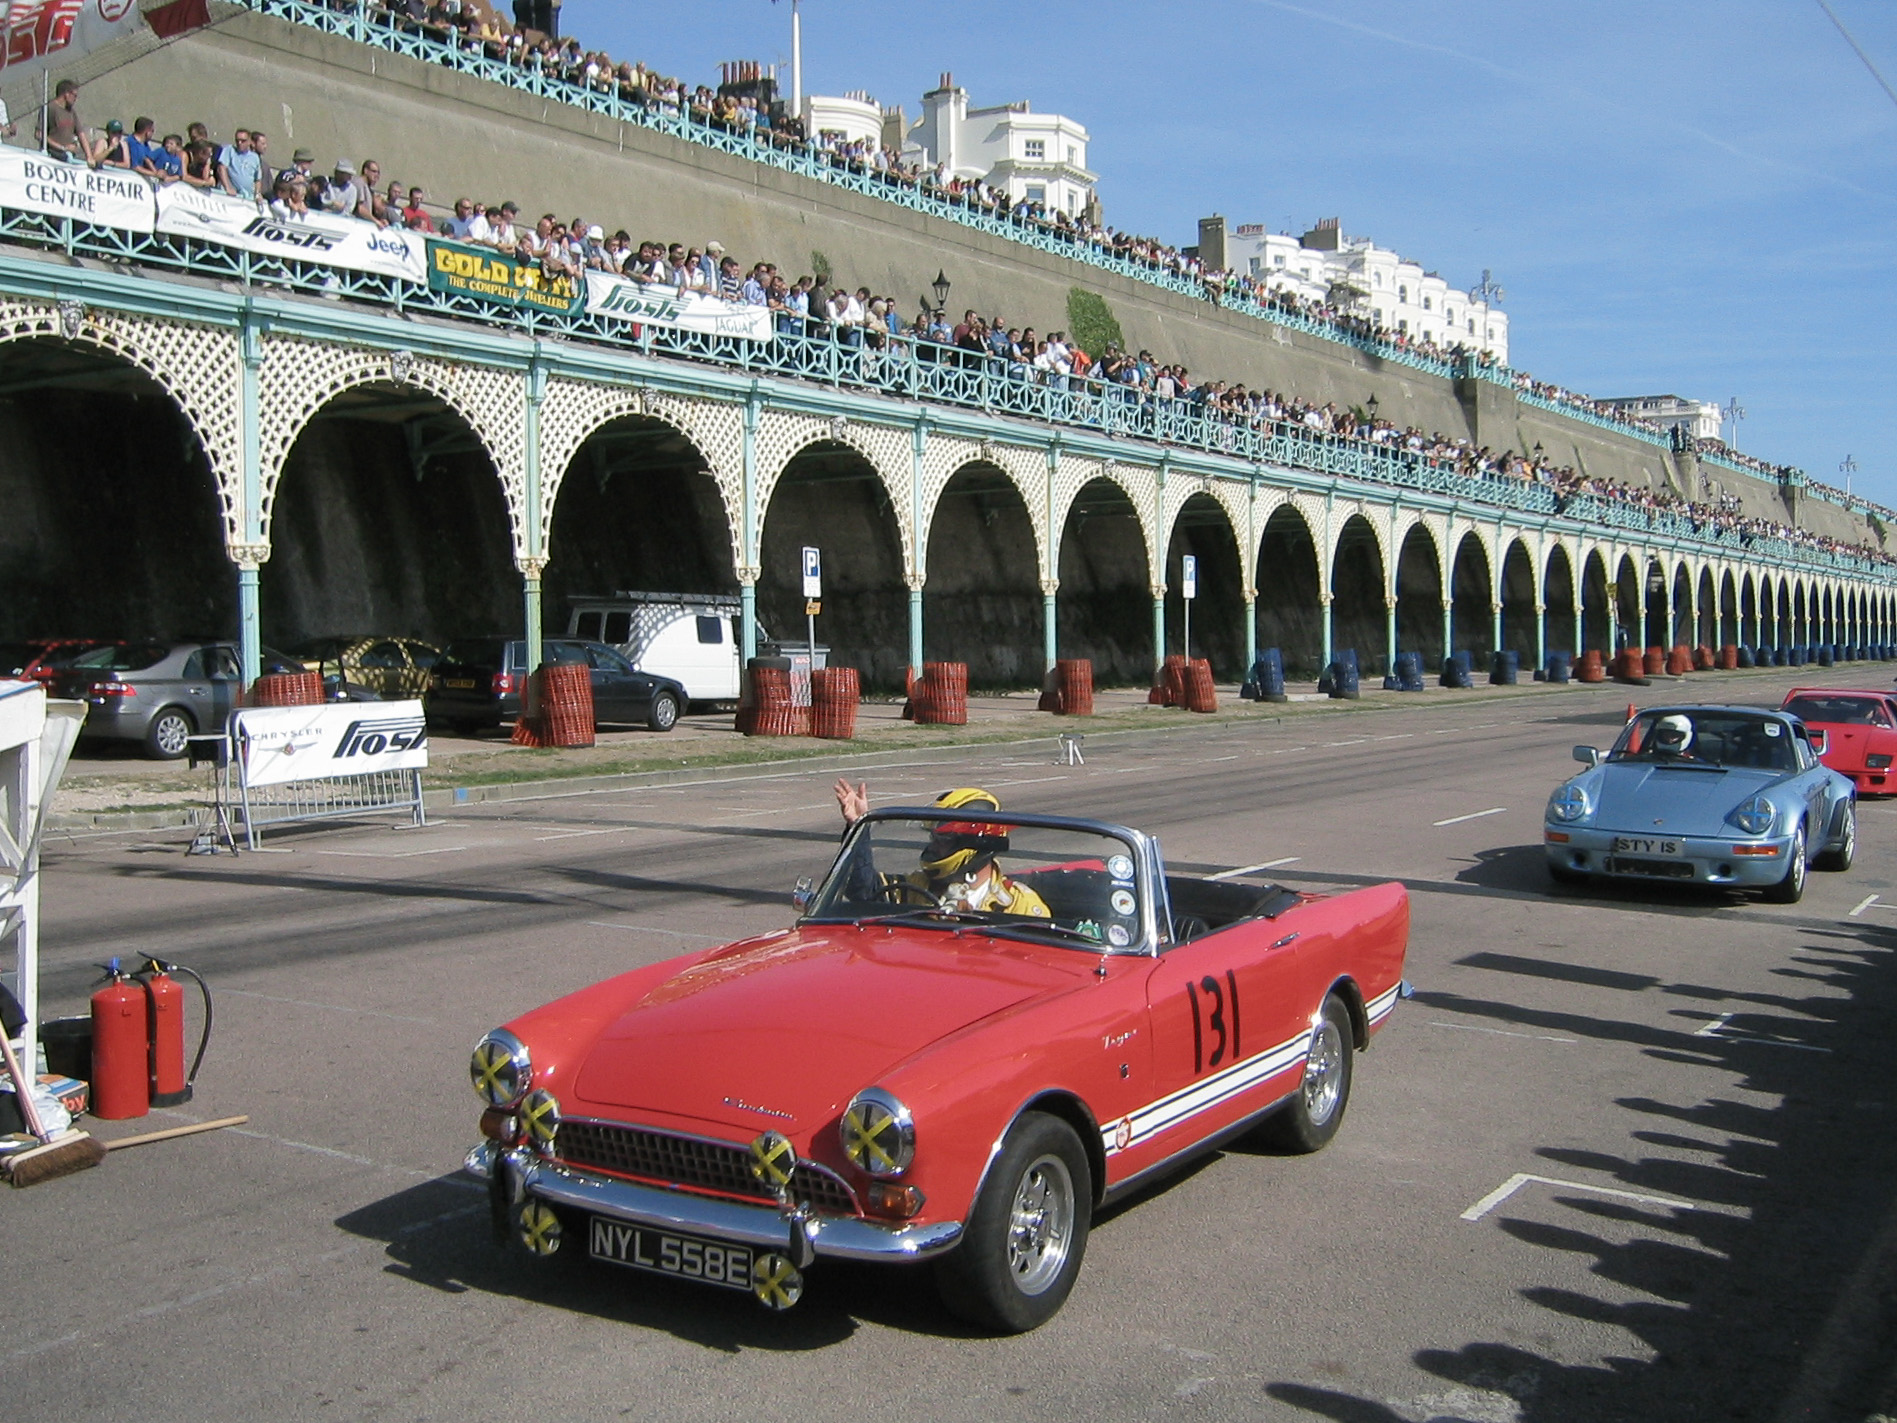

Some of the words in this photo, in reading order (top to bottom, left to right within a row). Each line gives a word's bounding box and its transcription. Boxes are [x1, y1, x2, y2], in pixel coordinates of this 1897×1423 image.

[23, 160, 78, 186] BODY
[86, 173, 144, 201] REPAIR
[25, 183, 96, 213] CENTRE
[366, 232, 410, 262] Jeep
[434, 247, 509, 284] GOLD
[448, 275, 466, 289] THE
[469, 280, 520, 299] COMPLETE
[715, 316, 758, 335] JAGUAR
[806, 551, 817, 576] P
[250, 727, 322, 741] CHRYSLER
[1186, 969, 1240, 1075] 131
[594, 1221, 654, 1266] NYL
[661, 1236, 749, 1285] 558E
